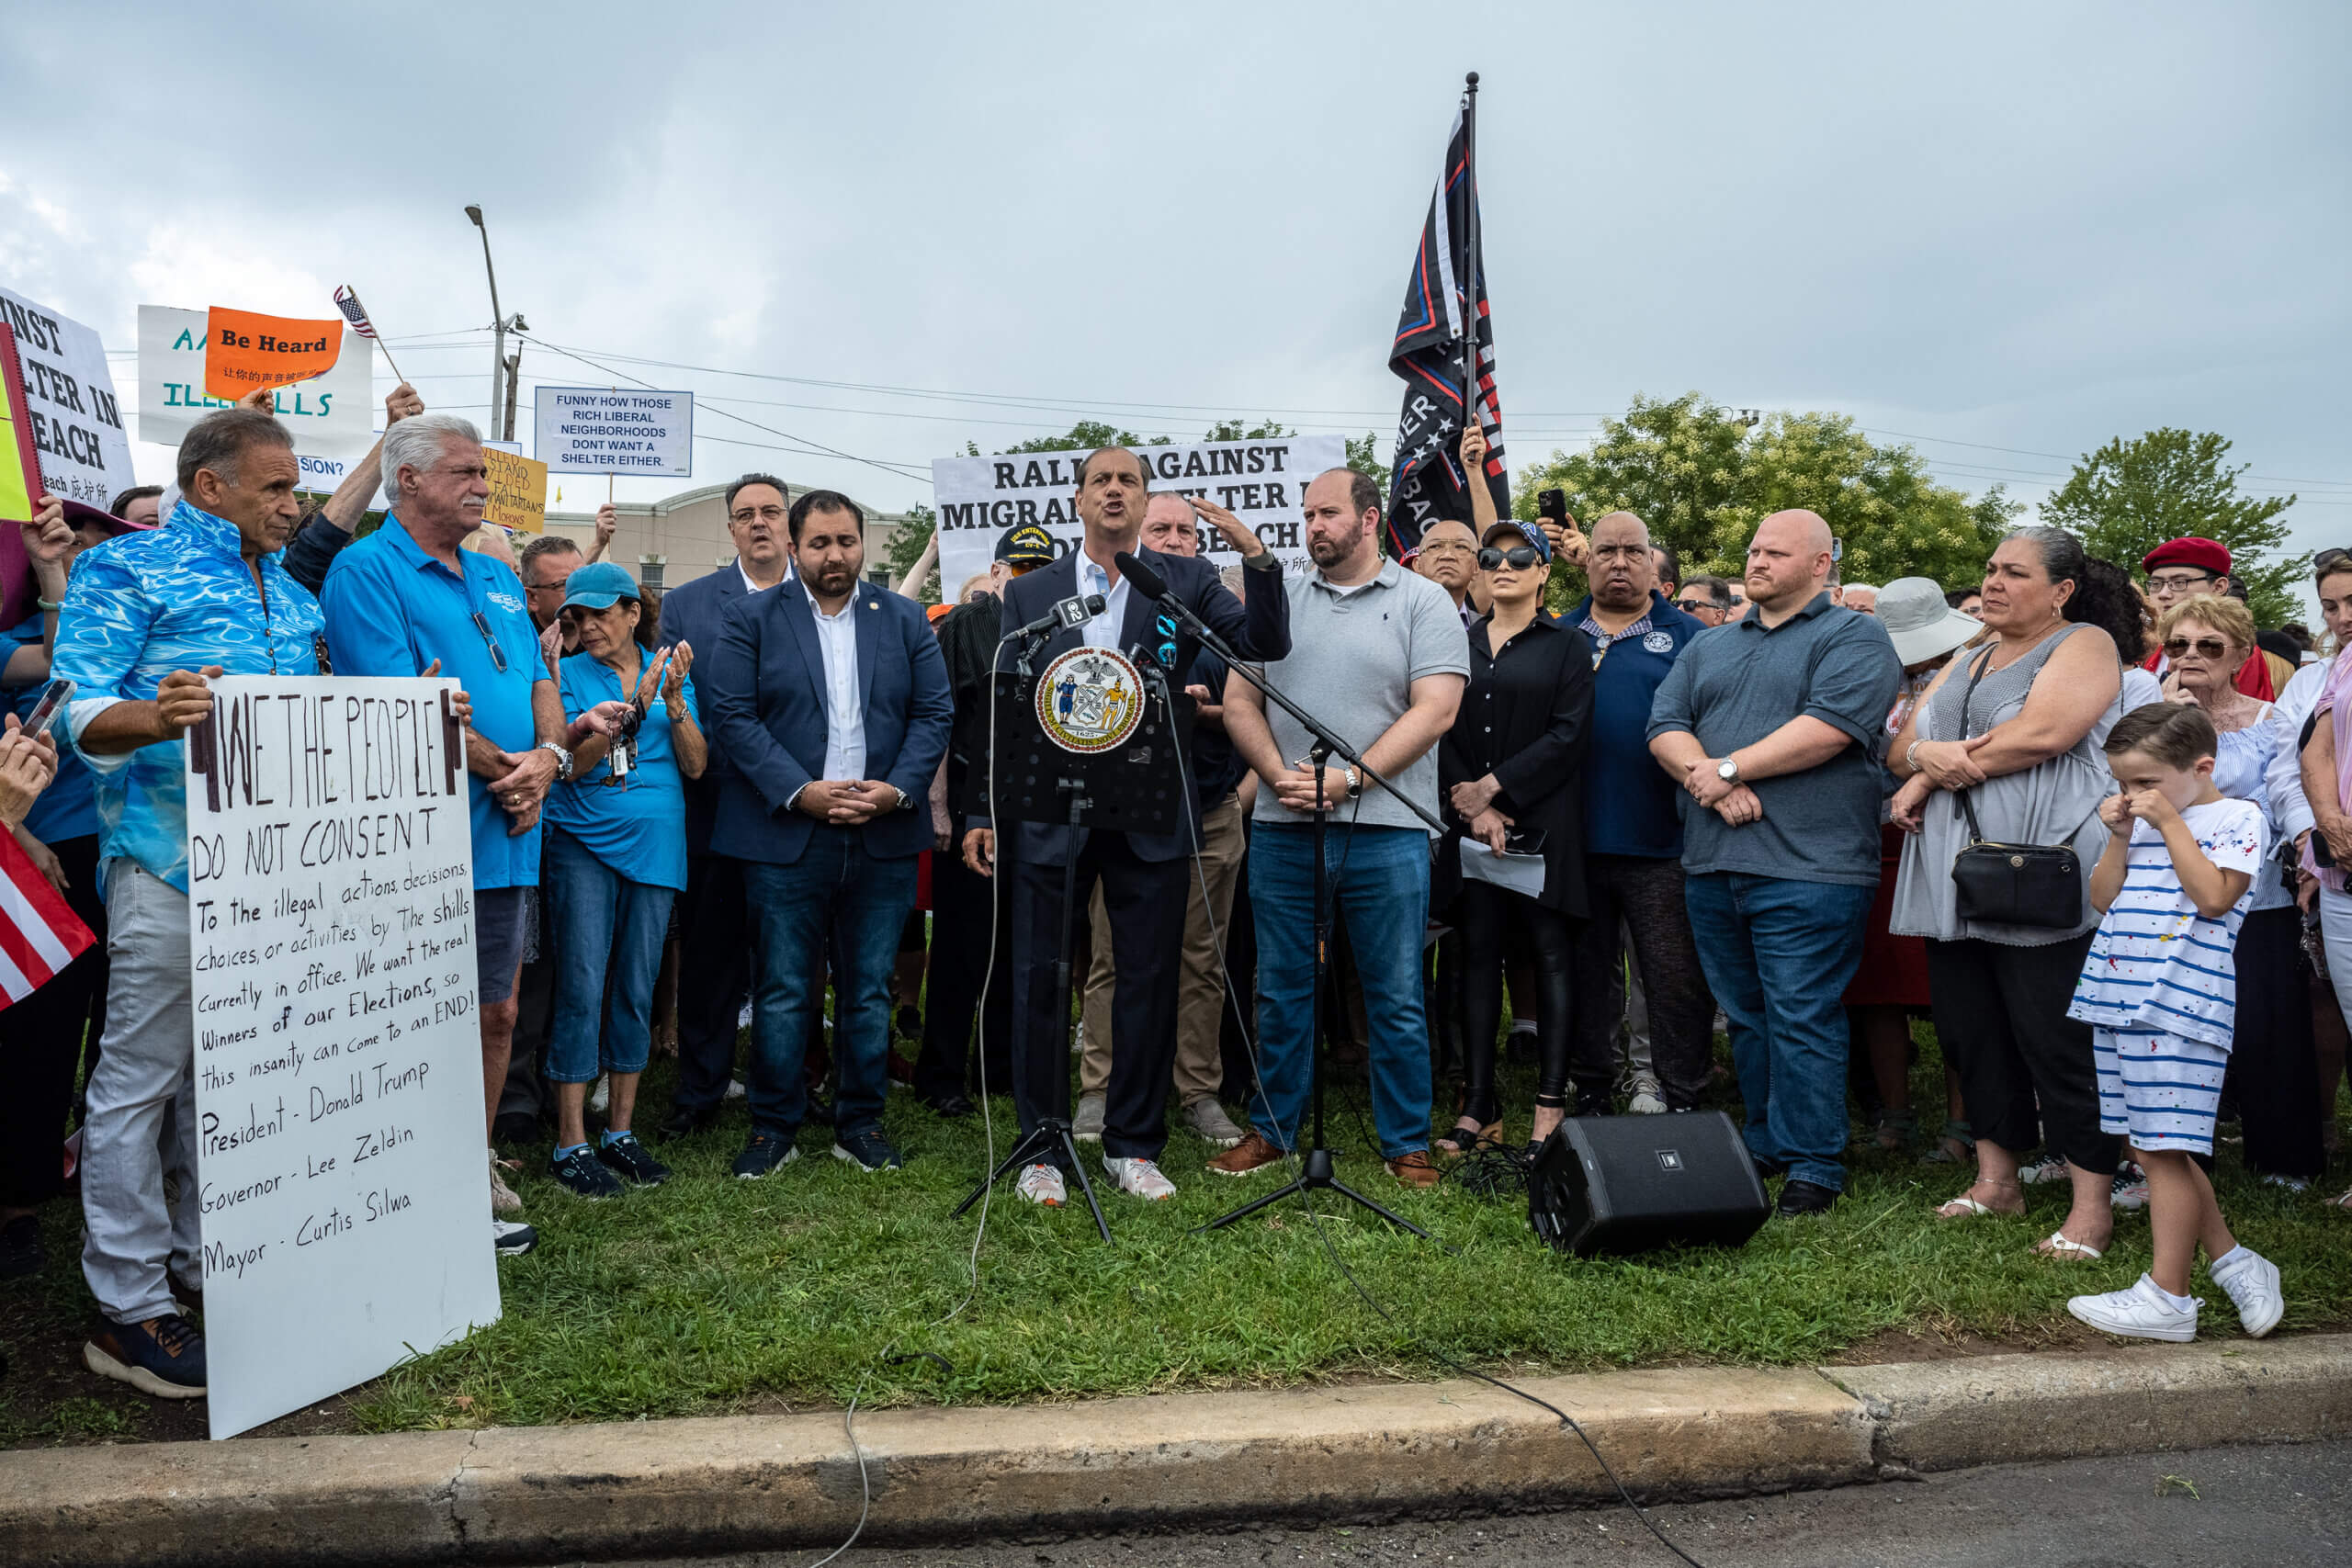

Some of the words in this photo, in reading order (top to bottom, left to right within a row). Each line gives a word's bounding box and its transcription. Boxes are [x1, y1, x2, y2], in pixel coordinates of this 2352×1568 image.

[220, 330, 250, 348] Be
[258, 335, 327, 353] Heard
[88, 385, 122, 429] IN
[557, 395, 596, 406] FUNNY
[600, 396, 628, 407] HOW
[632, 398, 672, 409] THOSE
[561, 424, 666, 437] NEIGHBORHOODS
[573, 410, 601, 421] RICH
[605, 412, 654, 423] LIBERAL
[561, 454, 616, 465] SHELTER
[618, 456, 664, 467] EITHER.
[572, 440, 605, 450] DONT
[608, 441, 643, 451] WANT
[646, 443, 654, 452] A
[219, 692, 274, 808] WE
[278, 694, 337, 808] THE
[346, 695, 437, 804] PEOPLE
[193, 834, 225, 882] DO
[245, 823, 290, 874] NOT
[300, 807, 437, 866] CONSENT
[197, 900, 218, 933] To
[230, 897, 261, 926] the
[274, 882, 323, 927] illegal
[342, 869, 398, 903] actions,
[403, 861, 468, 891] decisions,
[265, 942, 283, 959] or
[290, 920, 356, 953] activities
[371, 914, 390, 946] by
[434, 887, 469, 923] shills
[275, 982, 288, 998] in
[298, 962, 345, 994] office.
[356, 949, 375, 979] We
[383, 941, 414, 971] want
[421, 939, 440, 961] the
[445, 923, 468, 952] real
[201, 1026, 257, 1051] Winners
[273, 1006, 292, 1032] of
[304, 1008, 335, 1026] our
[349, 977, 435, 1017] Elections,
[444, 974, 459, 987] so
[201, 1065, 234, 1091] this
[249, 1040, 304, 1077] insanity
[313, 1043, 338, 1060] can
[386, 1021, 401, 1041] to
[411, 1017, 429, 1031] an
[435, 990, 474, 1024] END!
[201, 1096, 285, 1157] President
[310, 1071, 363, 1122] Donald
[372, 1062, 429, 1099] Trump
[199, 1176, 282, 1213] Governor
[309, 1155, 335, 1179] Lee
[354, 1125, 413, 1163] Zeldin
[204, 1241, 266, 1280] Mayor
[296, 1206, 352, 1246] Curtis
[367, 1188, 412, 1222] Silwa
